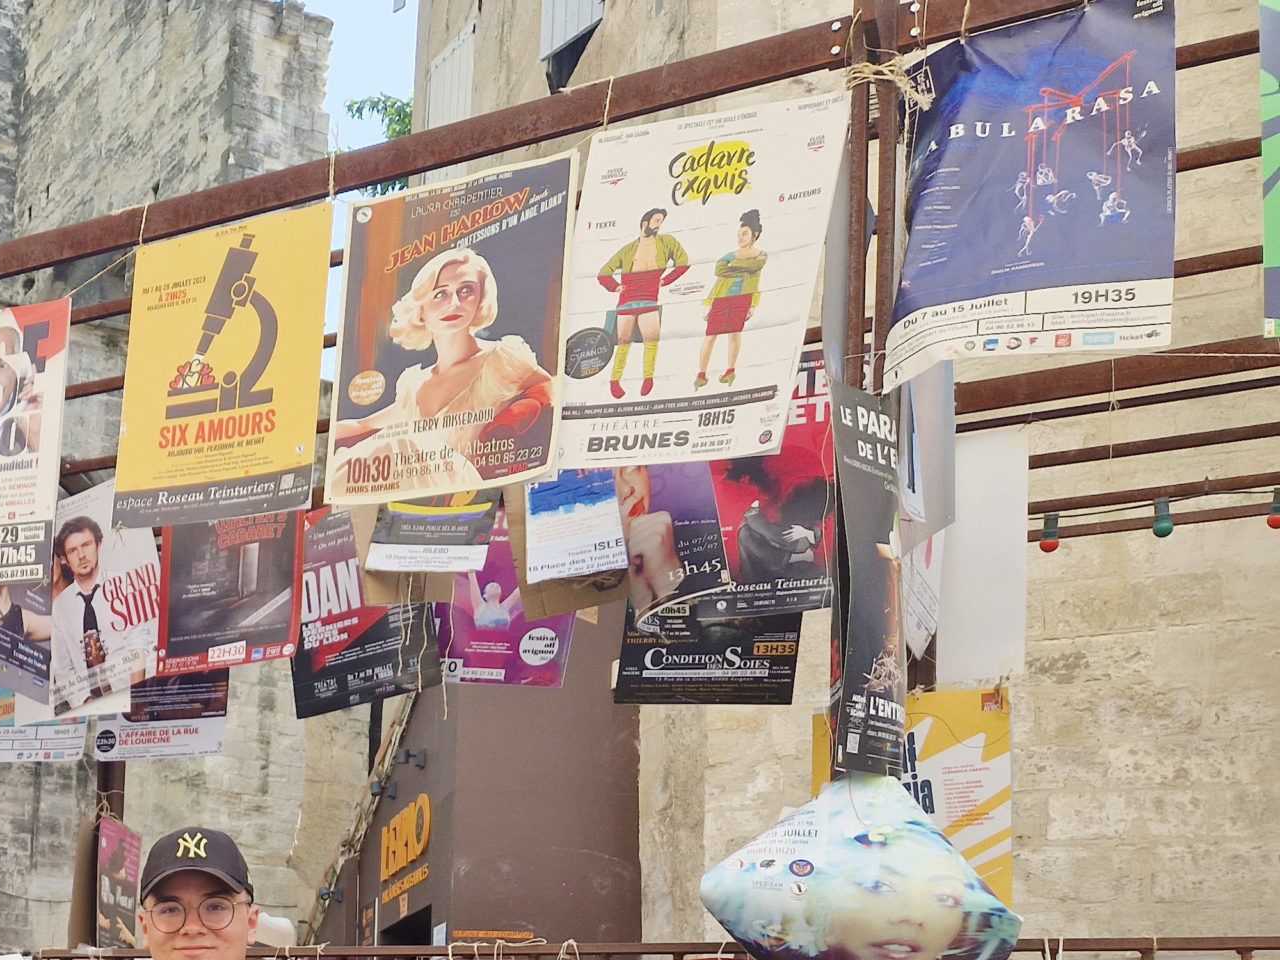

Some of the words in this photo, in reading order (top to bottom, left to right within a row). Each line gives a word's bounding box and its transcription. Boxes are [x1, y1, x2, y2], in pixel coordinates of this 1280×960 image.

[1064, 79, 1161, 126] RASA
[669, 141, 756, 178] Cadavre
[671, 167, 752, 206] exquis
[787, 188, 821, 201] AUTEURS
[411, 202, 441, 218] LAURA
[443, 187, 503, 209] CHARPENTIER
[385, 232, 435, 273] JEAN
[441, 187, 530, 244] HARLOW
[595, 220, 617, 229] TEXTE
[1071, 288, 1137, 305] 19H35
[903, 316, 918, 330] Du
[921, 313, 928, 324] 7
[931, 310, 949, 321] au
[951, 304, 965, 316] 15
[969, 298, 1009, 312] Juillet
[158, 424, 189, 449] SIX
[195, 409, 276, 443] AMOURS
[413, 419, 439, 434] TERRY
[443, 408, 494, 429] MISSERAOUI
[590, 418, 660, 432] THÉÂTRE
[697, 409, 735, 427] 18H15
[587, 430, 689, 453] BRUNES
[346, 454, 392, 483] 10h30
[117, 493, 152, 509] espace
[158, 487, 204, 505] Roseau
[207, 480, 275, 499] Teinturiers
[218, 523, 286, 549] CABARET
[668, 558, 721, 582] 13h45
[102, 562, 159, 603] GRAND
[109, 582, 161, 633] SOIR
[303, 617, 359, 638] DERNIERS
[528, 634, 558, 644] festival
[210, 645, 245, 658] 22H30
[522, 648, 555, 657] avignon
[644, 647, 723, 669] CONDITION
[755, 643, 795, 654] 13H35
[119, 731, 157, 739] L'AFFAIRE
[184, 727, 199, 735] RUE
[119, 738, 129, 746] DE
[131, 736, 170, 745] LOURCINE
[176, 831, 208, 858] NY
